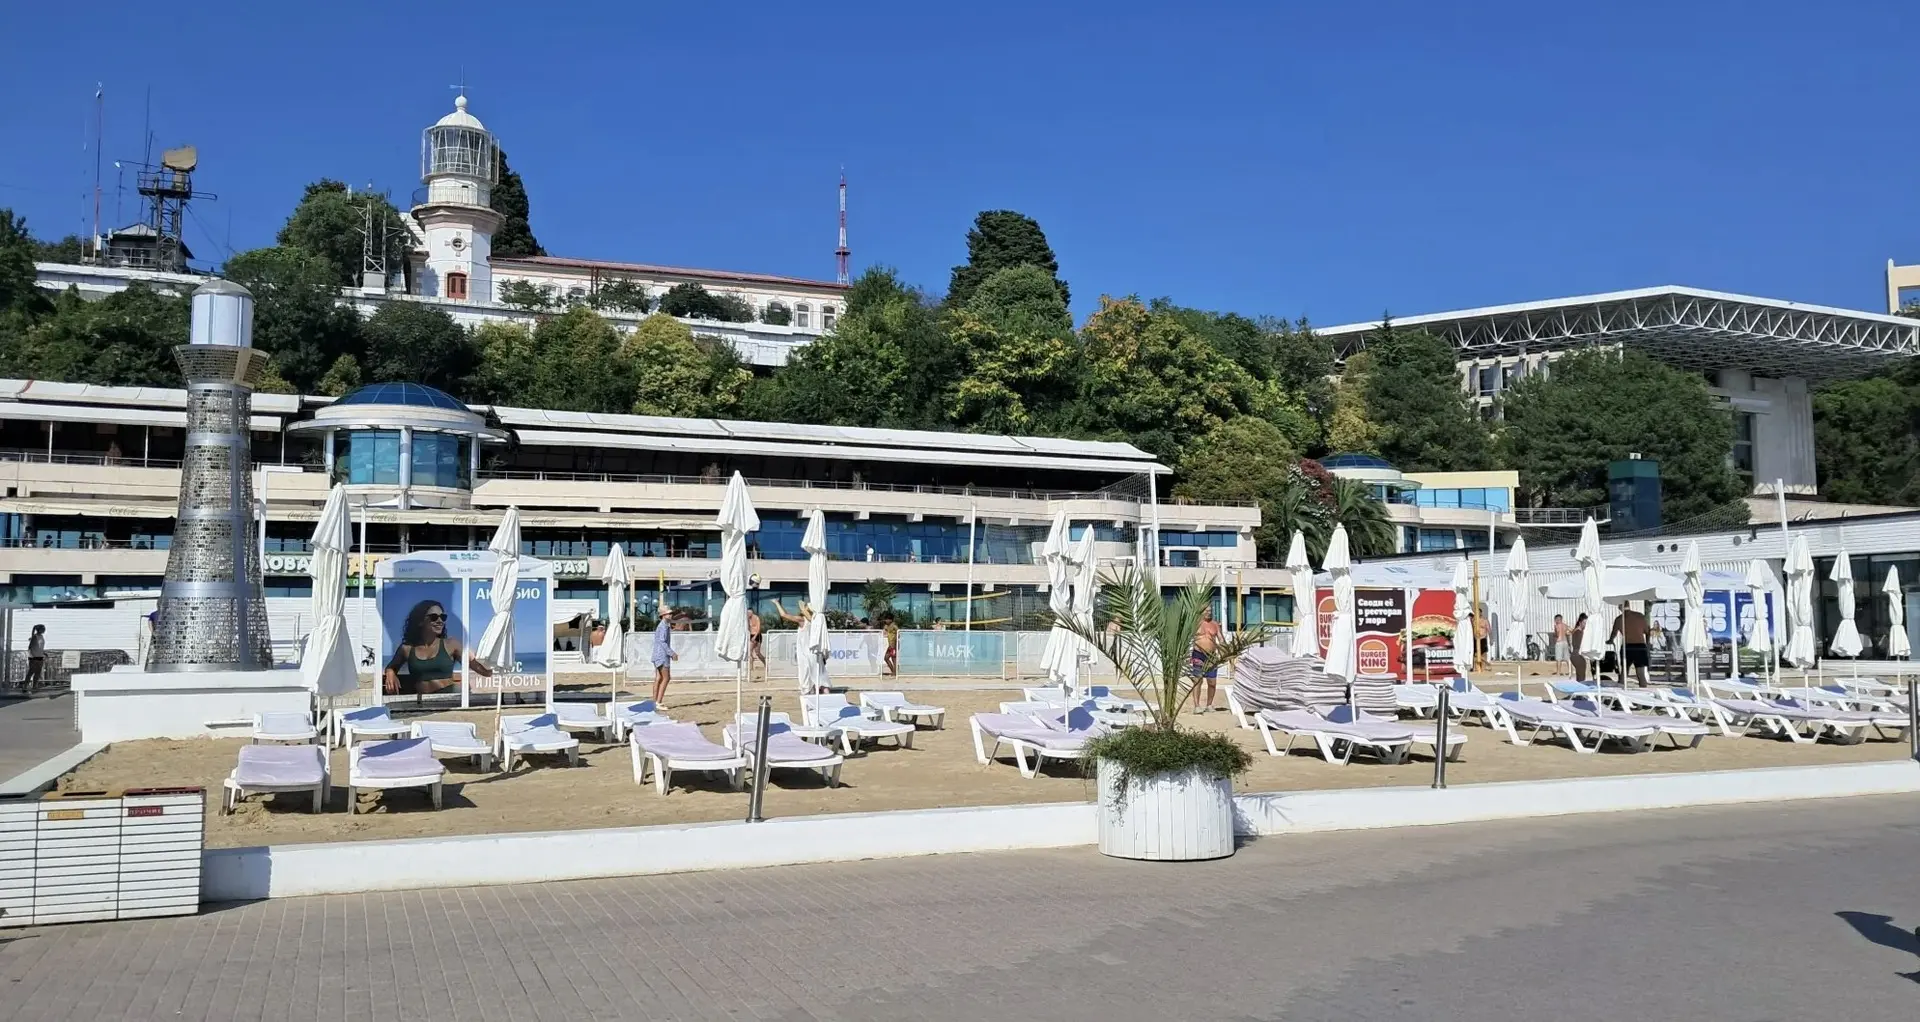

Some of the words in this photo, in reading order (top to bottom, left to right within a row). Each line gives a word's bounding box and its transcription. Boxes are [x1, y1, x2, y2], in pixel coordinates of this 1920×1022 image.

[1320, 614, 1335, 623] BUR
[1320, 624, 1332, 638] KI
[936, 644, 975, 657] МАЯК
[1360, 658, 1386, 668] KING
